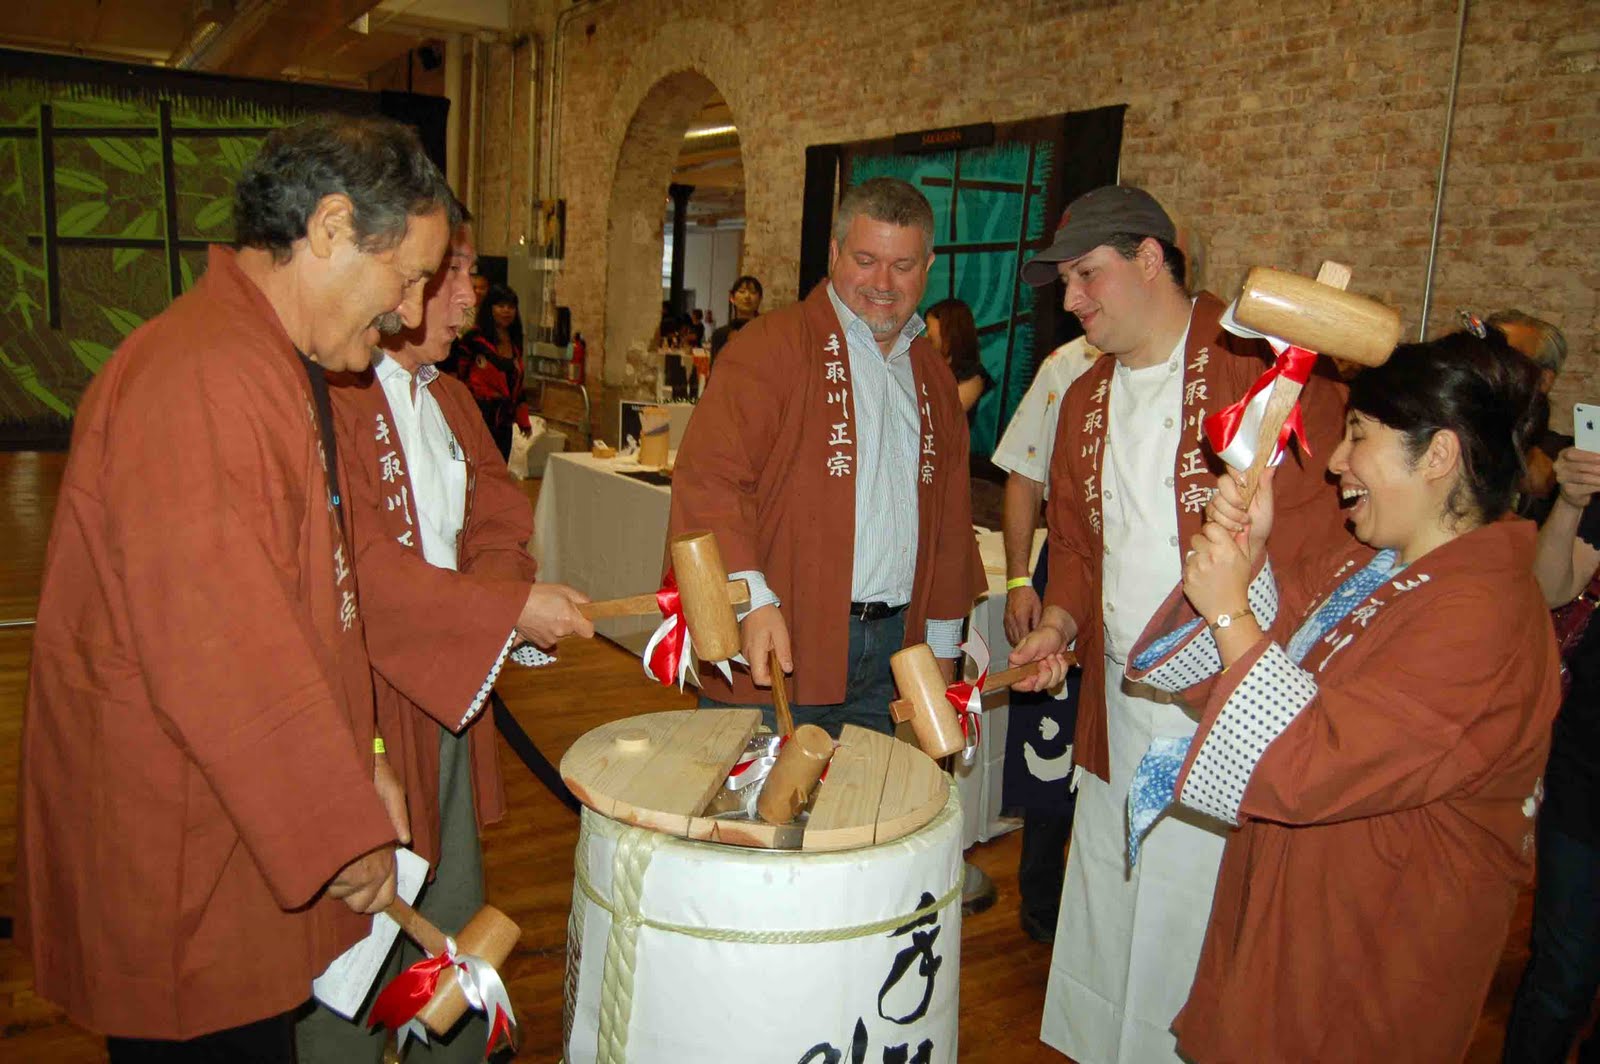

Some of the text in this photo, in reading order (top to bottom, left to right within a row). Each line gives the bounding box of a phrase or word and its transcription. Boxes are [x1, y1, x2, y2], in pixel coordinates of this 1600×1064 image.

[824, 333, 853, 478] 手取川正宗
[1179, 347, 1213, 514] 手取川正宗
